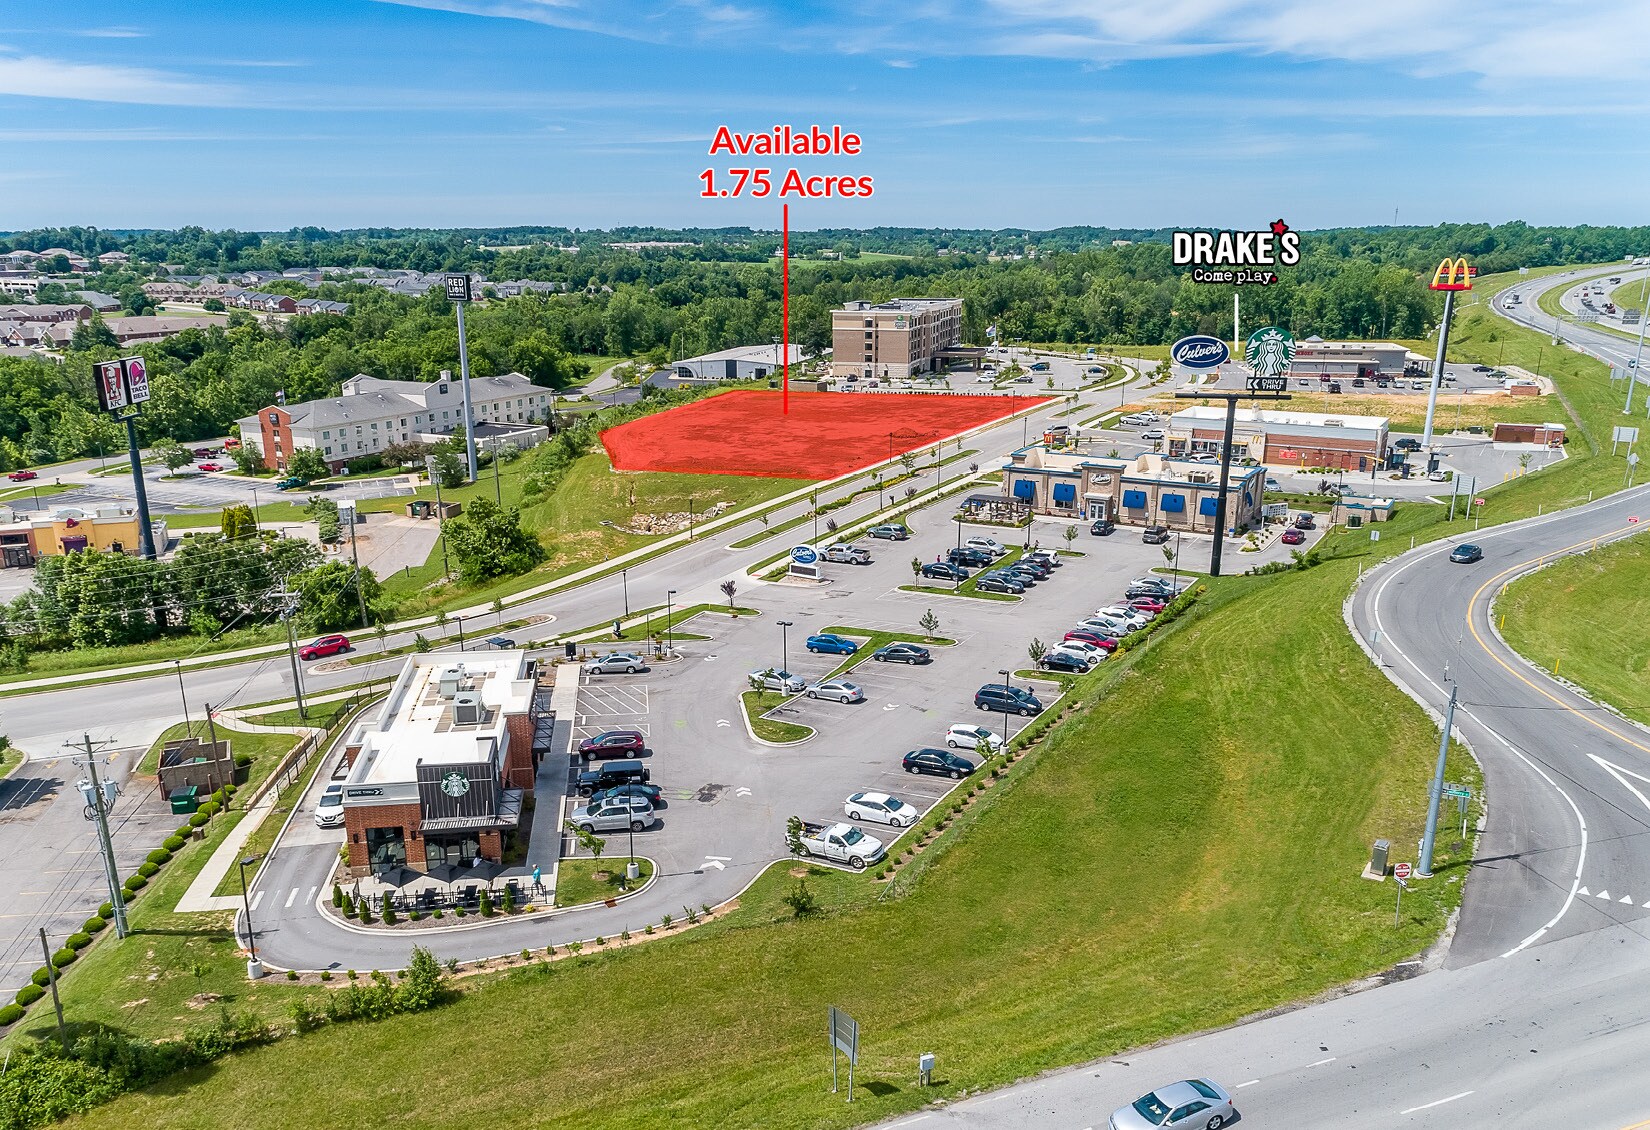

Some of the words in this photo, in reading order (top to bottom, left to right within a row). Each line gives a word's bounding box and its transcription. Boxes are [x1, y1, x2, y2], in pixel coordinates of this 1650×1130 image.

[448, 278, 464, 287] RED
[1176, 342, 1223, 362] Culver's
[131, 385, 147, 394] TACO
[133, 391, 148, 400] BELL
